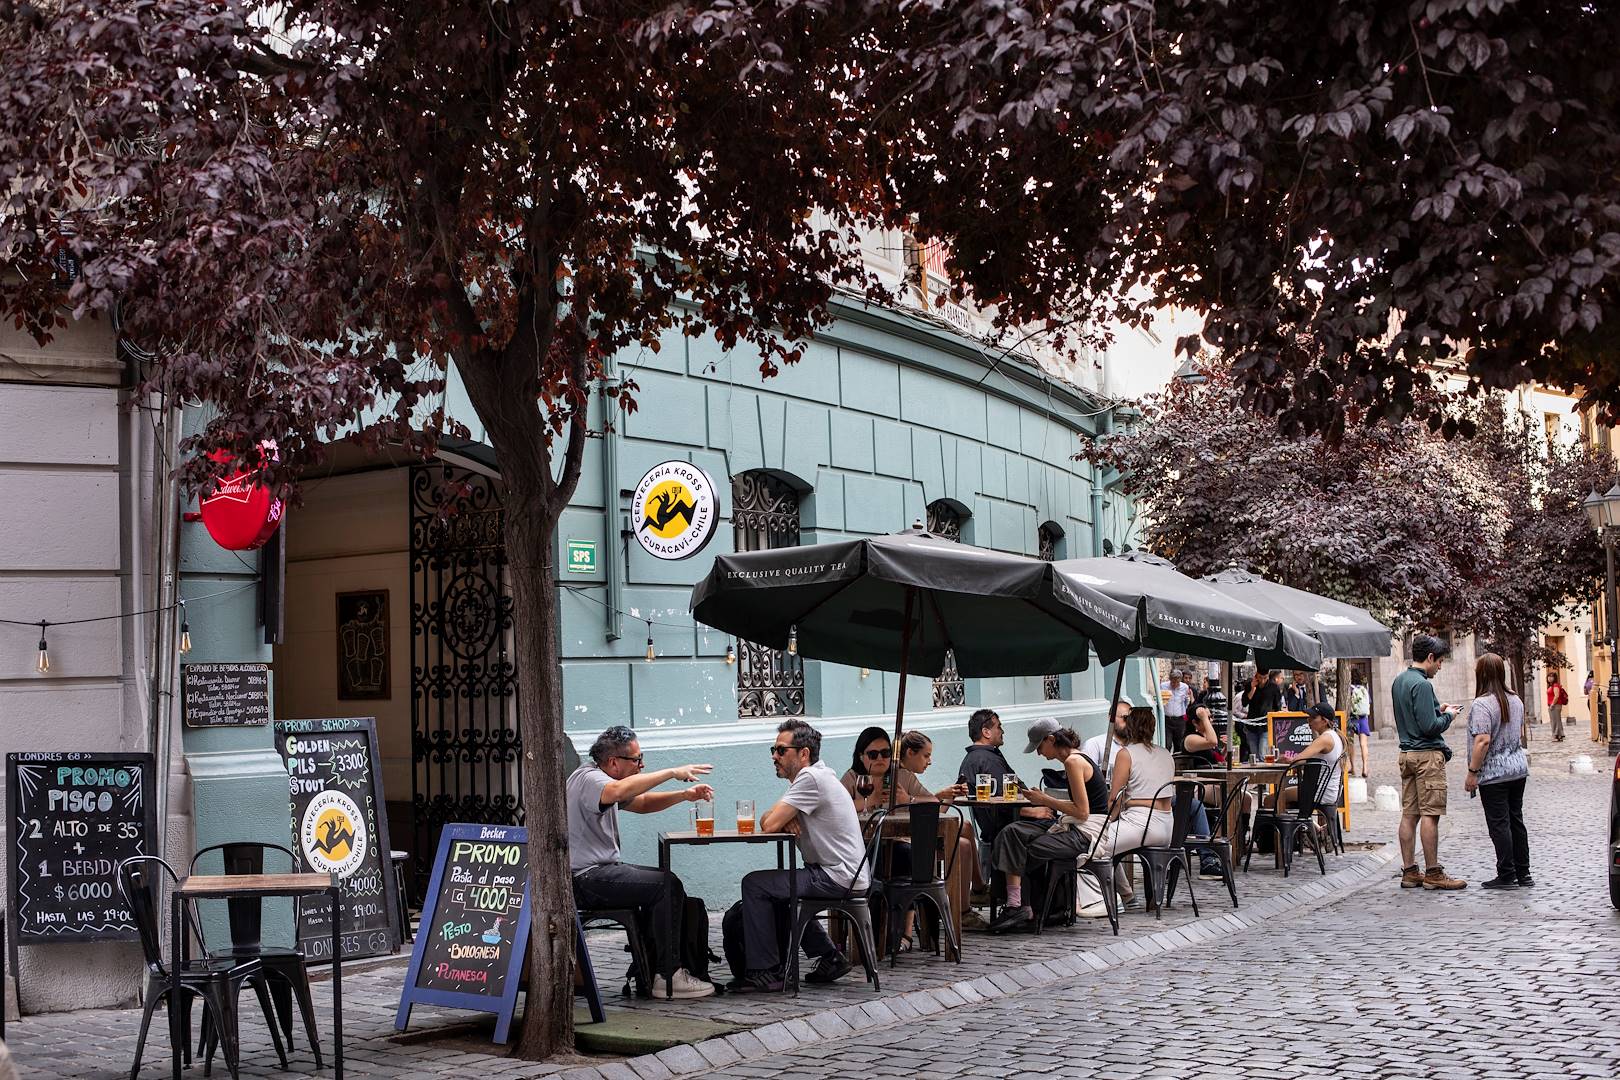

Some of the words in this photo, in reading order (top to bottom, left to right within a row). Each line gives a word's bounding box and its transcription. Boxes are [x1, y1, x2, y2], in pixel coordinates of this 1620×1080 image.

[634, 466, 670, 524] CERVECERÍA
[674, 467, 702, 491] KROSS
[727, 569, 781, 579] EXCLUSIVE
[785, 564, 825, 576] QUALITY
[830, 562, 847, 571] TEA
[1158, 613, 1206, 629] EXCLUSIVE
[1209, 624, 1247, 638] QUALITY
[1250, 633, 1268, 642] TEA
[284, 720, 313, 732] PROMO
[321, 719, 351, 731] SCHOP
[286, 735, 331, 755] GOLDEN
[18, 752, 63, 761] LONDRES
[67, 752, 81, 760] 68
[287, 757, 316, 775] PILS
[336, 752, 364, 772] 3300
[57, 766, 132, 788] PROMO
[289, 776, 325, 795] STOUT
[48, 789, 113, 813] PISCO
[29, 818, 43, 839] 2
[53, 820, 89, 838] ALTO
[97, 823, 113, 833] DE
[288, 798, 301, 862] PROM
[306, 796, 335, 844] CERVECERÍA
[337, 798, 359, 822] KROSS
[366, 795, 378, 857] PROMO
[480, 826, 508, 839] Becker
[452, 842, 521, 866] PROMO
[38, 860, 53, 877] 1
[450, 866, 473, 884] Pasta
[478, 869, 489, 885] al
[493, 874, 516, 888] paso
[350, 875, 377, 893] 4000
[470, 887, 508, 910] 4000
[36, 911, 66, 924] HASTA
[77, 910, 96, 921] LAS
[352, 903, 377, 918] 19:00
[442, 921, 472, 941] PESTO
[303, 935, 361, 958] LONRES
[368, 931, 387, 952] 68
[450, 943, 500, 960] BOLOGNESA
[437, 962, 487, 983] PUTANESCA
